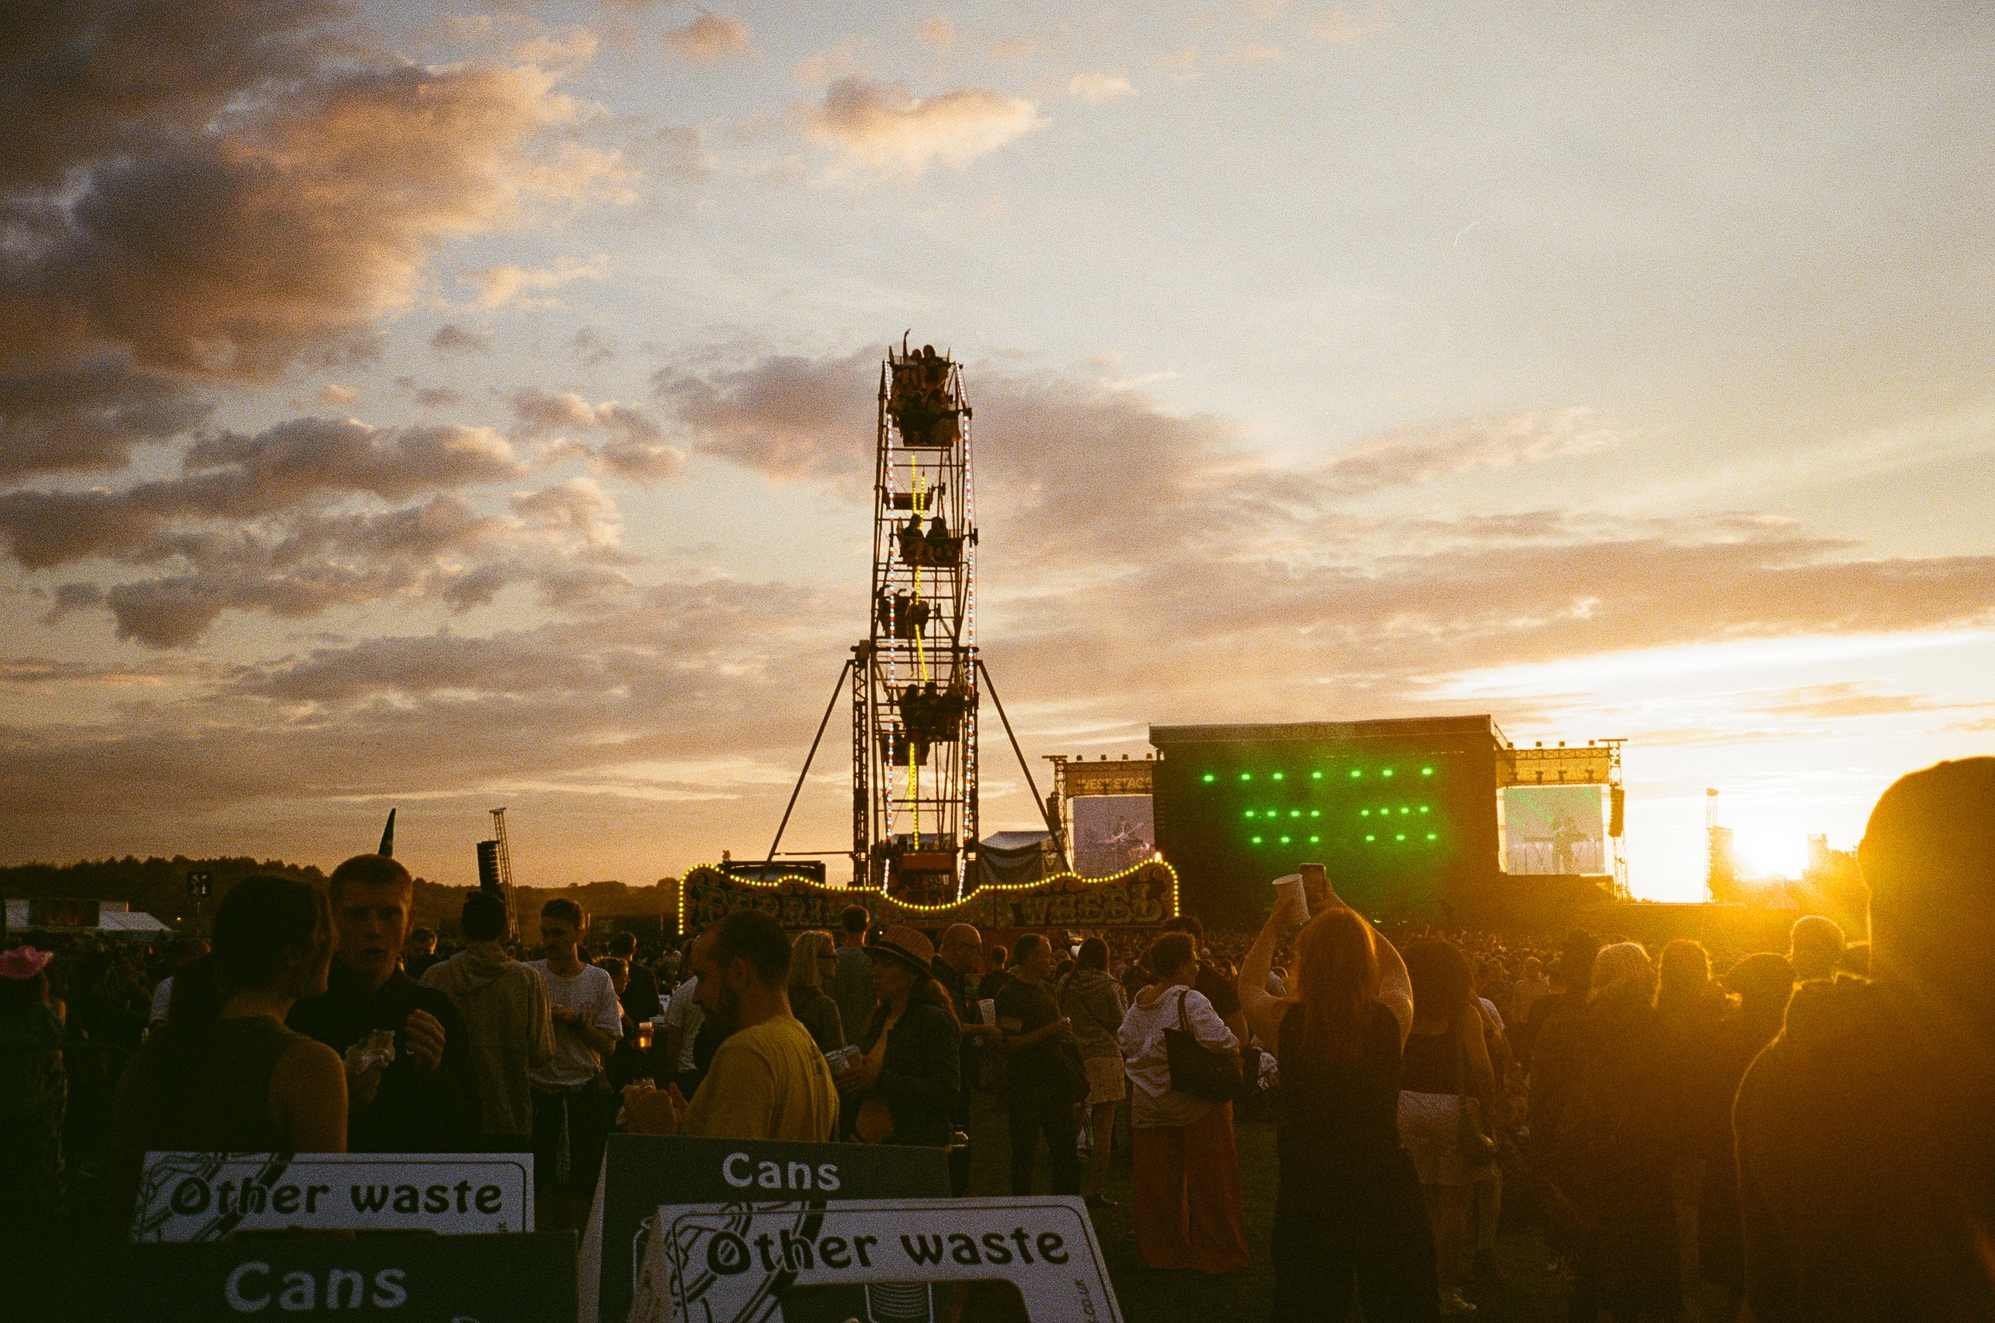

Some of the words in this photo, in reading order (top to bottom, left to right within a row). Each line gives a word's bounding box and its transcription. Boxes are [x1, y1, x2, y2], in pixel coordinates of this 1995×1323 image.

[720, 1151, 842, 1193] Cans
[170, 1177, 330, 1217] Other
[350, 1179, 504, 1216] waste
[706, 1226, 878, 1277] Other
[899, 1226, 1070, 1268] waste
[223, 1259, 410, 1313] Cans
